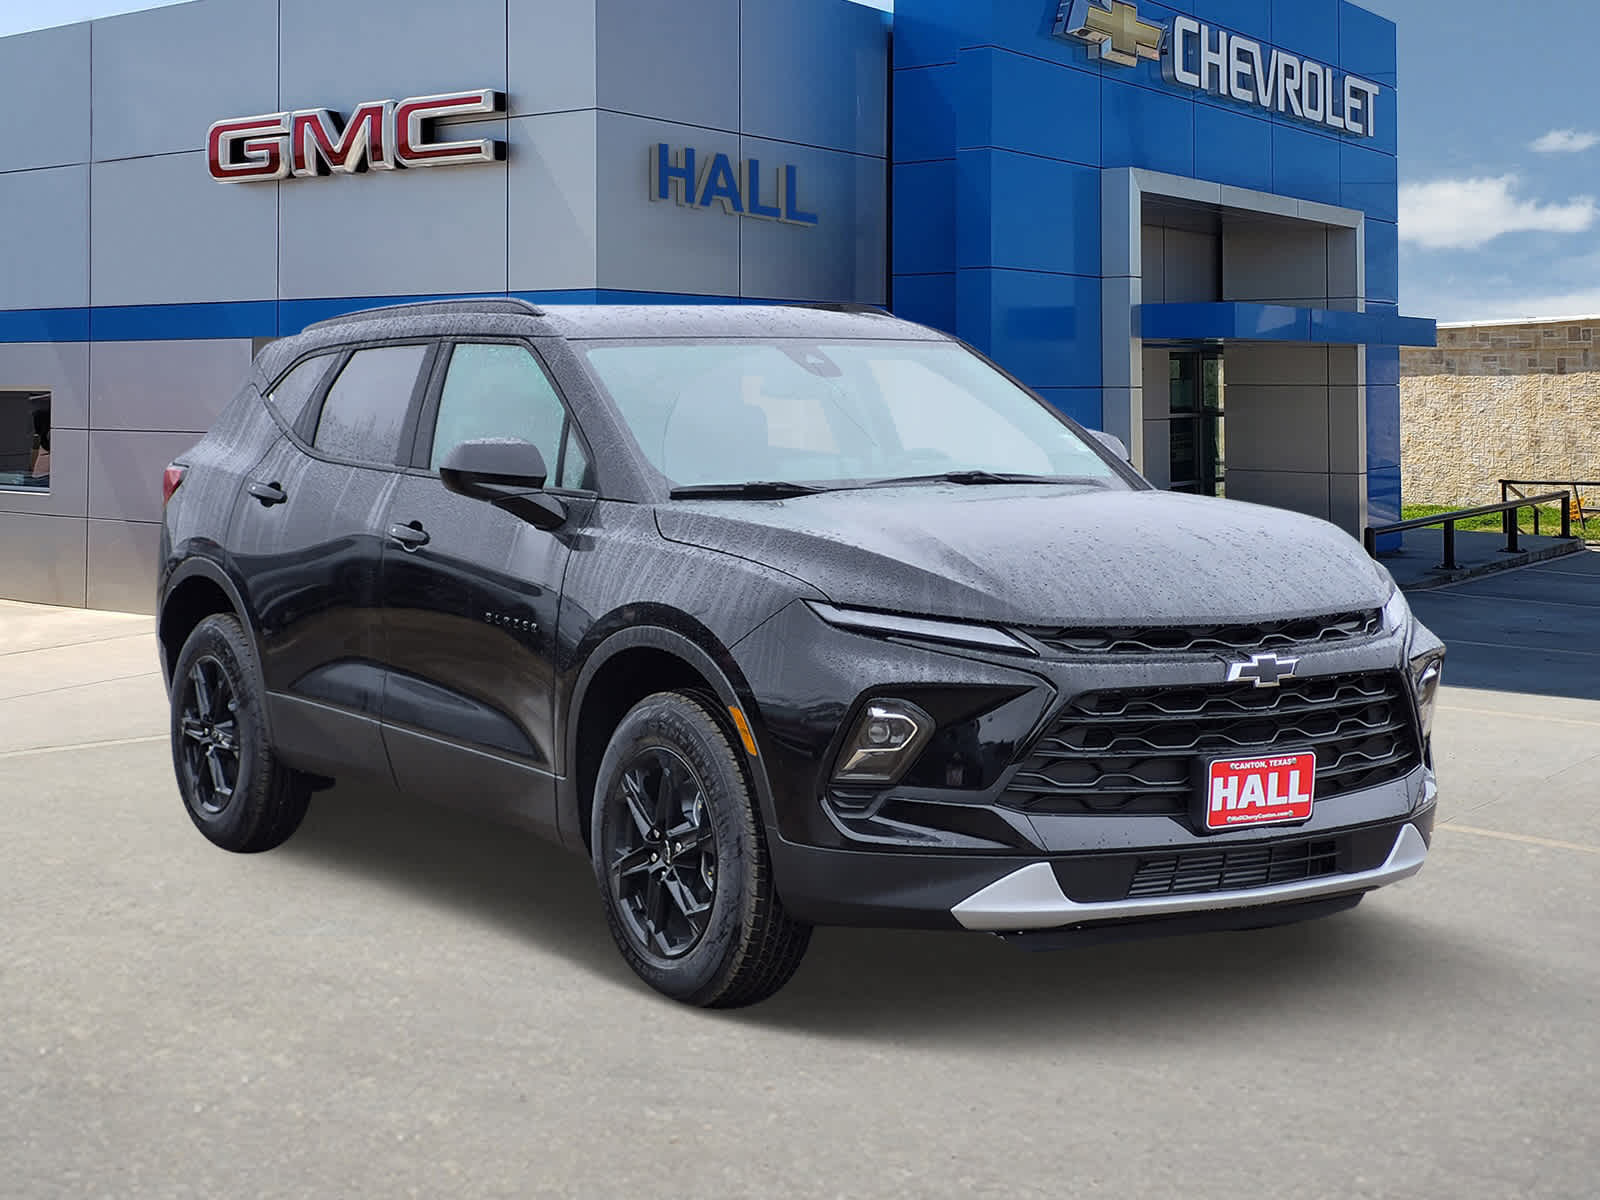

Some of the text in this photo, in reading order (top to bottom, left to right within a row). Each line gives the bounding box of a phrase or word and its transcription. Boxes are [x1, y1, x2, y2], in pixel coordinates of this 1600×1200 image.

[1173, 15, 1379, 137] CHEVROLET
[206, 88, 505, 183] GMC
[653, 143, 818, 225] HALL
[1211, 770, 1309, 811] HALL
[1269, 758, 1292, 767] TEXAS
